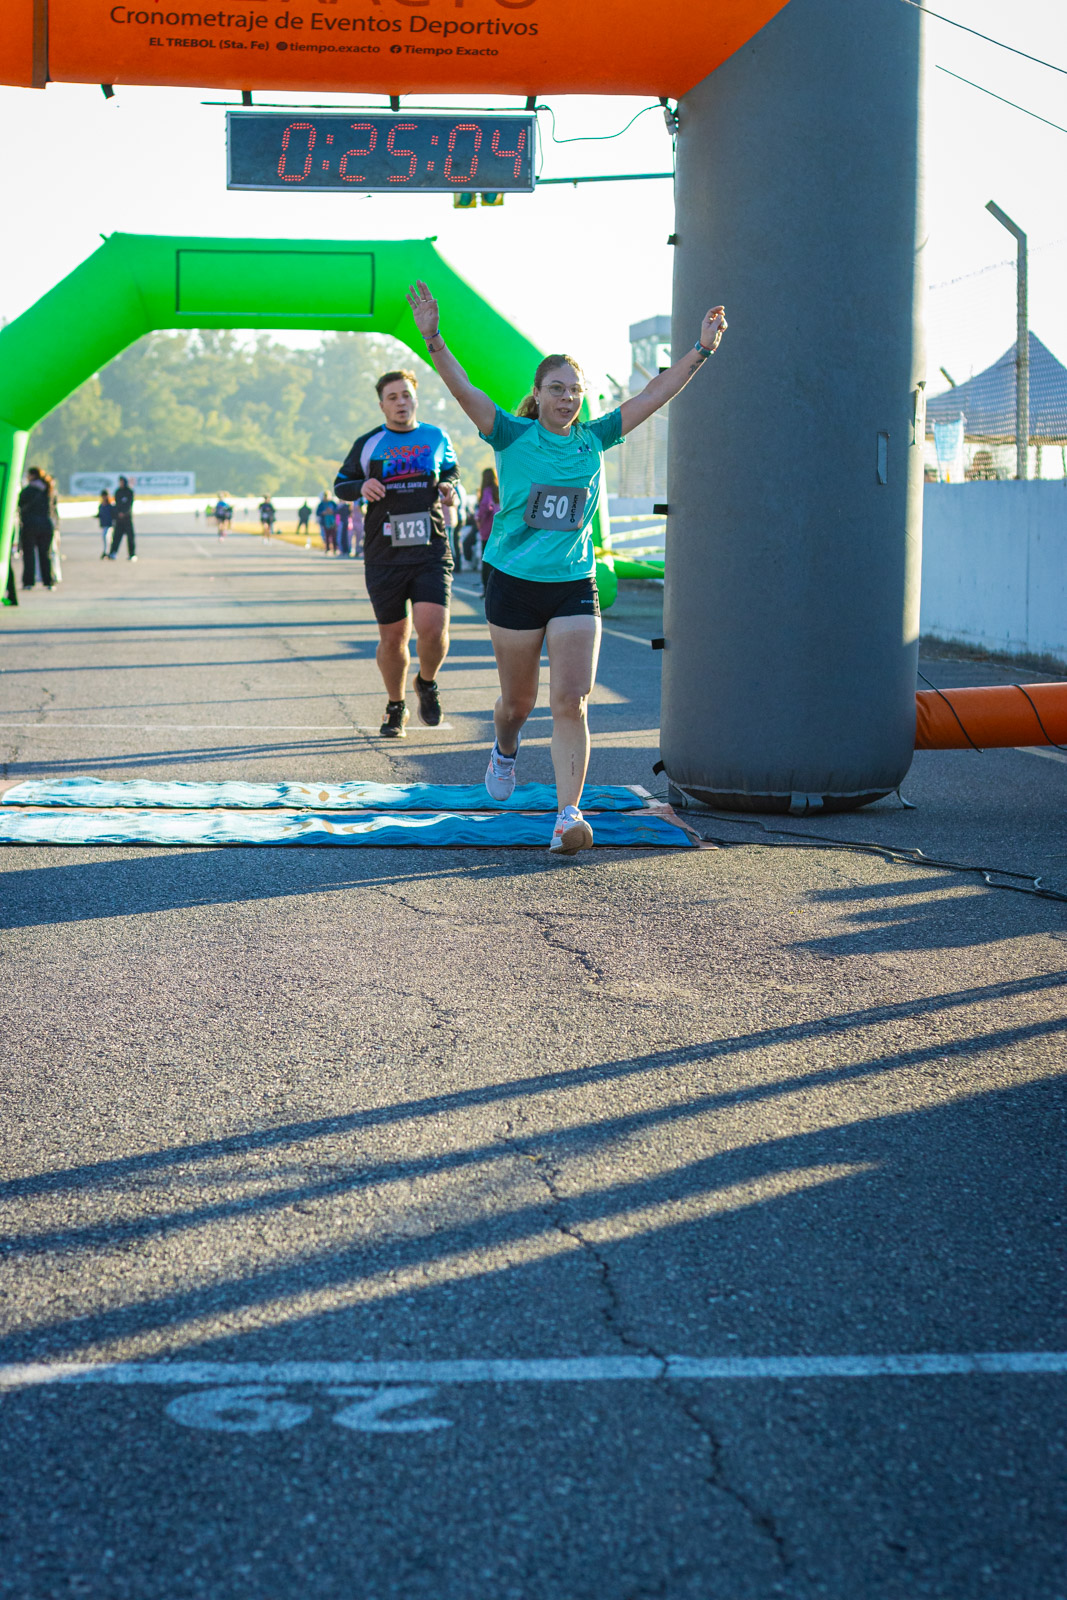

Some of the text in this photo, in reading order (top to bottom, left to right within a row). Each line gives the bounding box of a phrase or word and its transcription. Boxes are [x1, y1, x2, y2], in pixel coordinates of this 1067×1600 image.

[110, 6, 539, 38] Cronometraje de Eventos Deportivos
[149, 37, 270, 51] EL TREBOL (Sta. Fe)
[290, 43, 380, 54] tiempo.exacto
[404, 45, 499, 56] Tiempo Exacto
[277, 122, 526, 182] 0:25:04
[542, 495, 569, 519] 50
[398, 520, 425, 539] 173
